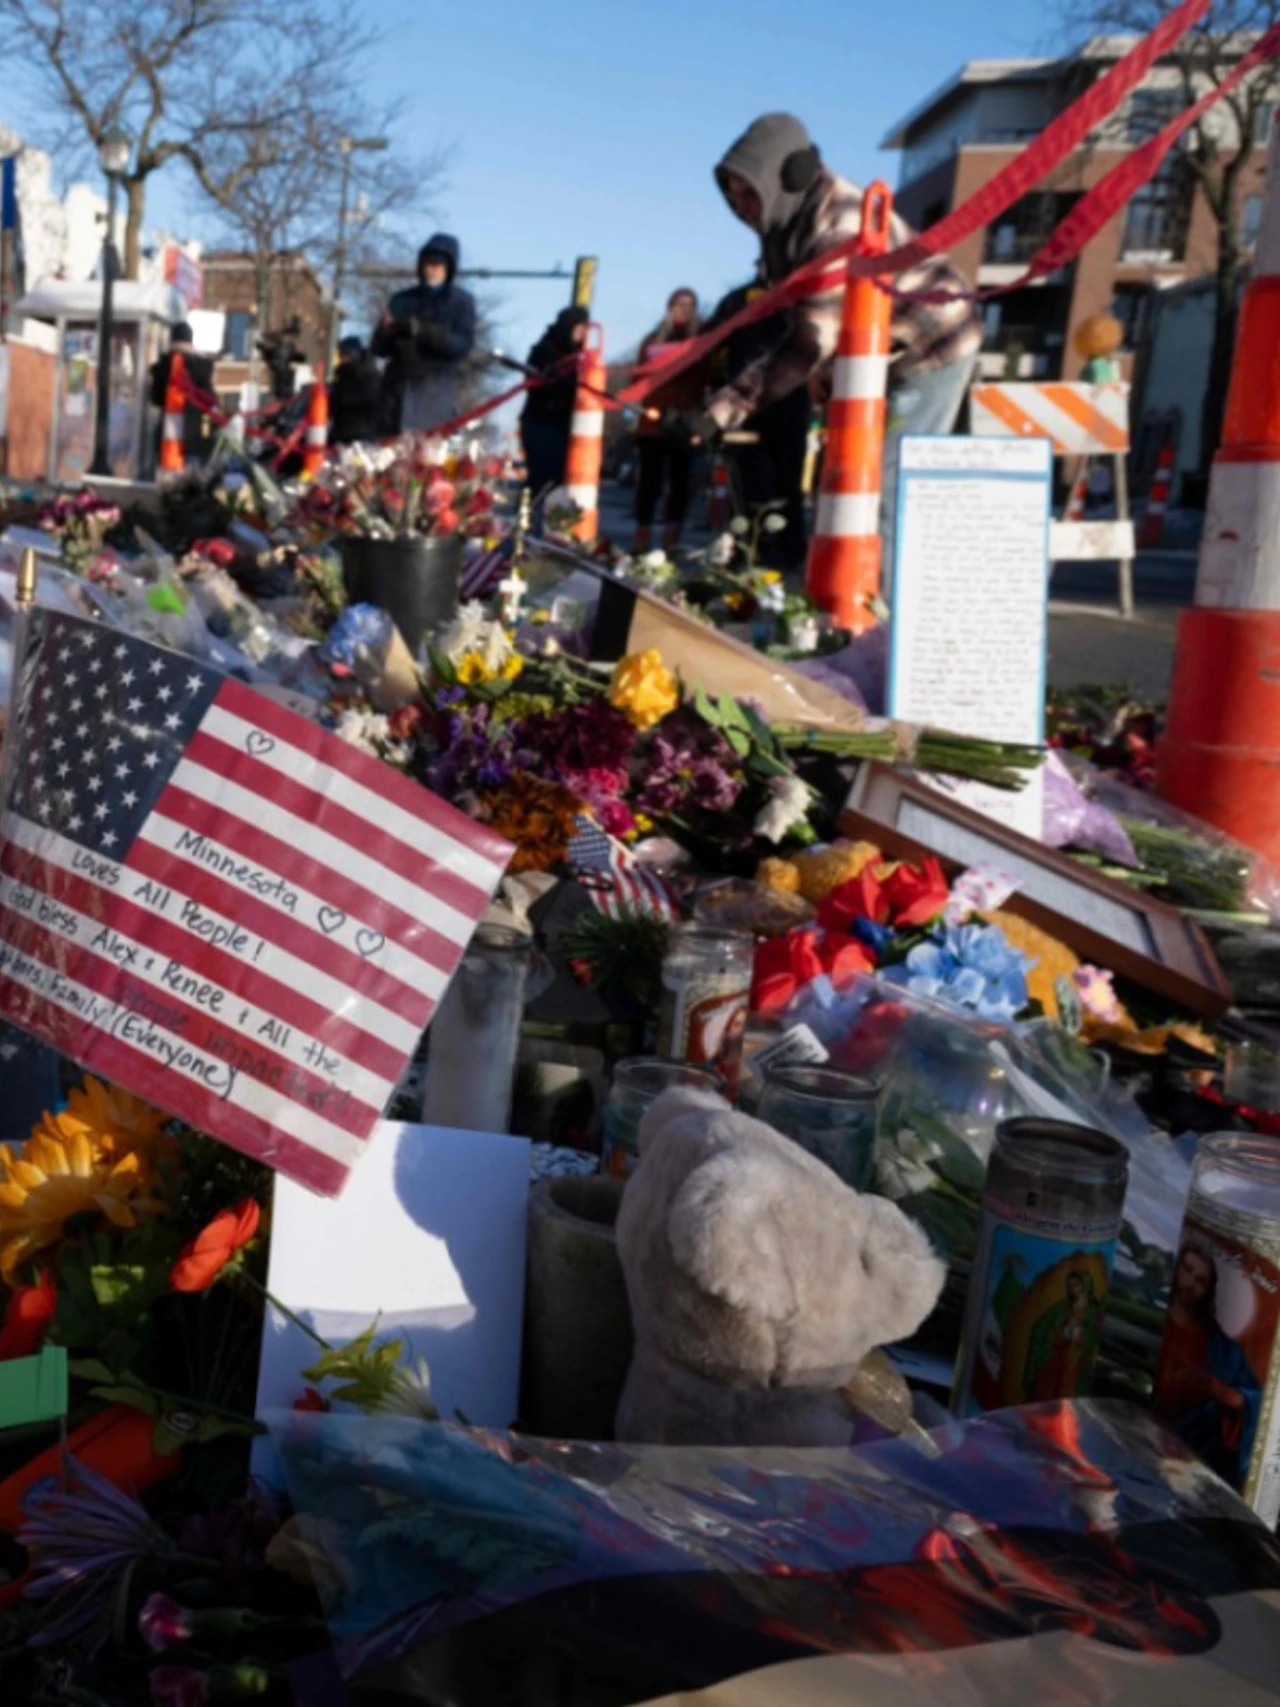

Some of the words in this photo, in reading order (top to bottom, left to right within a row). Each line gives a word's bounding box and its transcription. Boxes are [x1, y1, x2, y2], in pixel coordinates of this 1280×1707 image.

[71, 849, 120, 886] Loves
[134, 881, 171, 911] All
[175, 830, 298, 913] Minnesota
[90, 927, 138, 965] Alex
[161, 957, 226, 1014] Renee
[257, 1018, 291, 1048] All
[302, 1041, 342, 1077] the
[111, 1009, 237, 1101] (Everyone)
